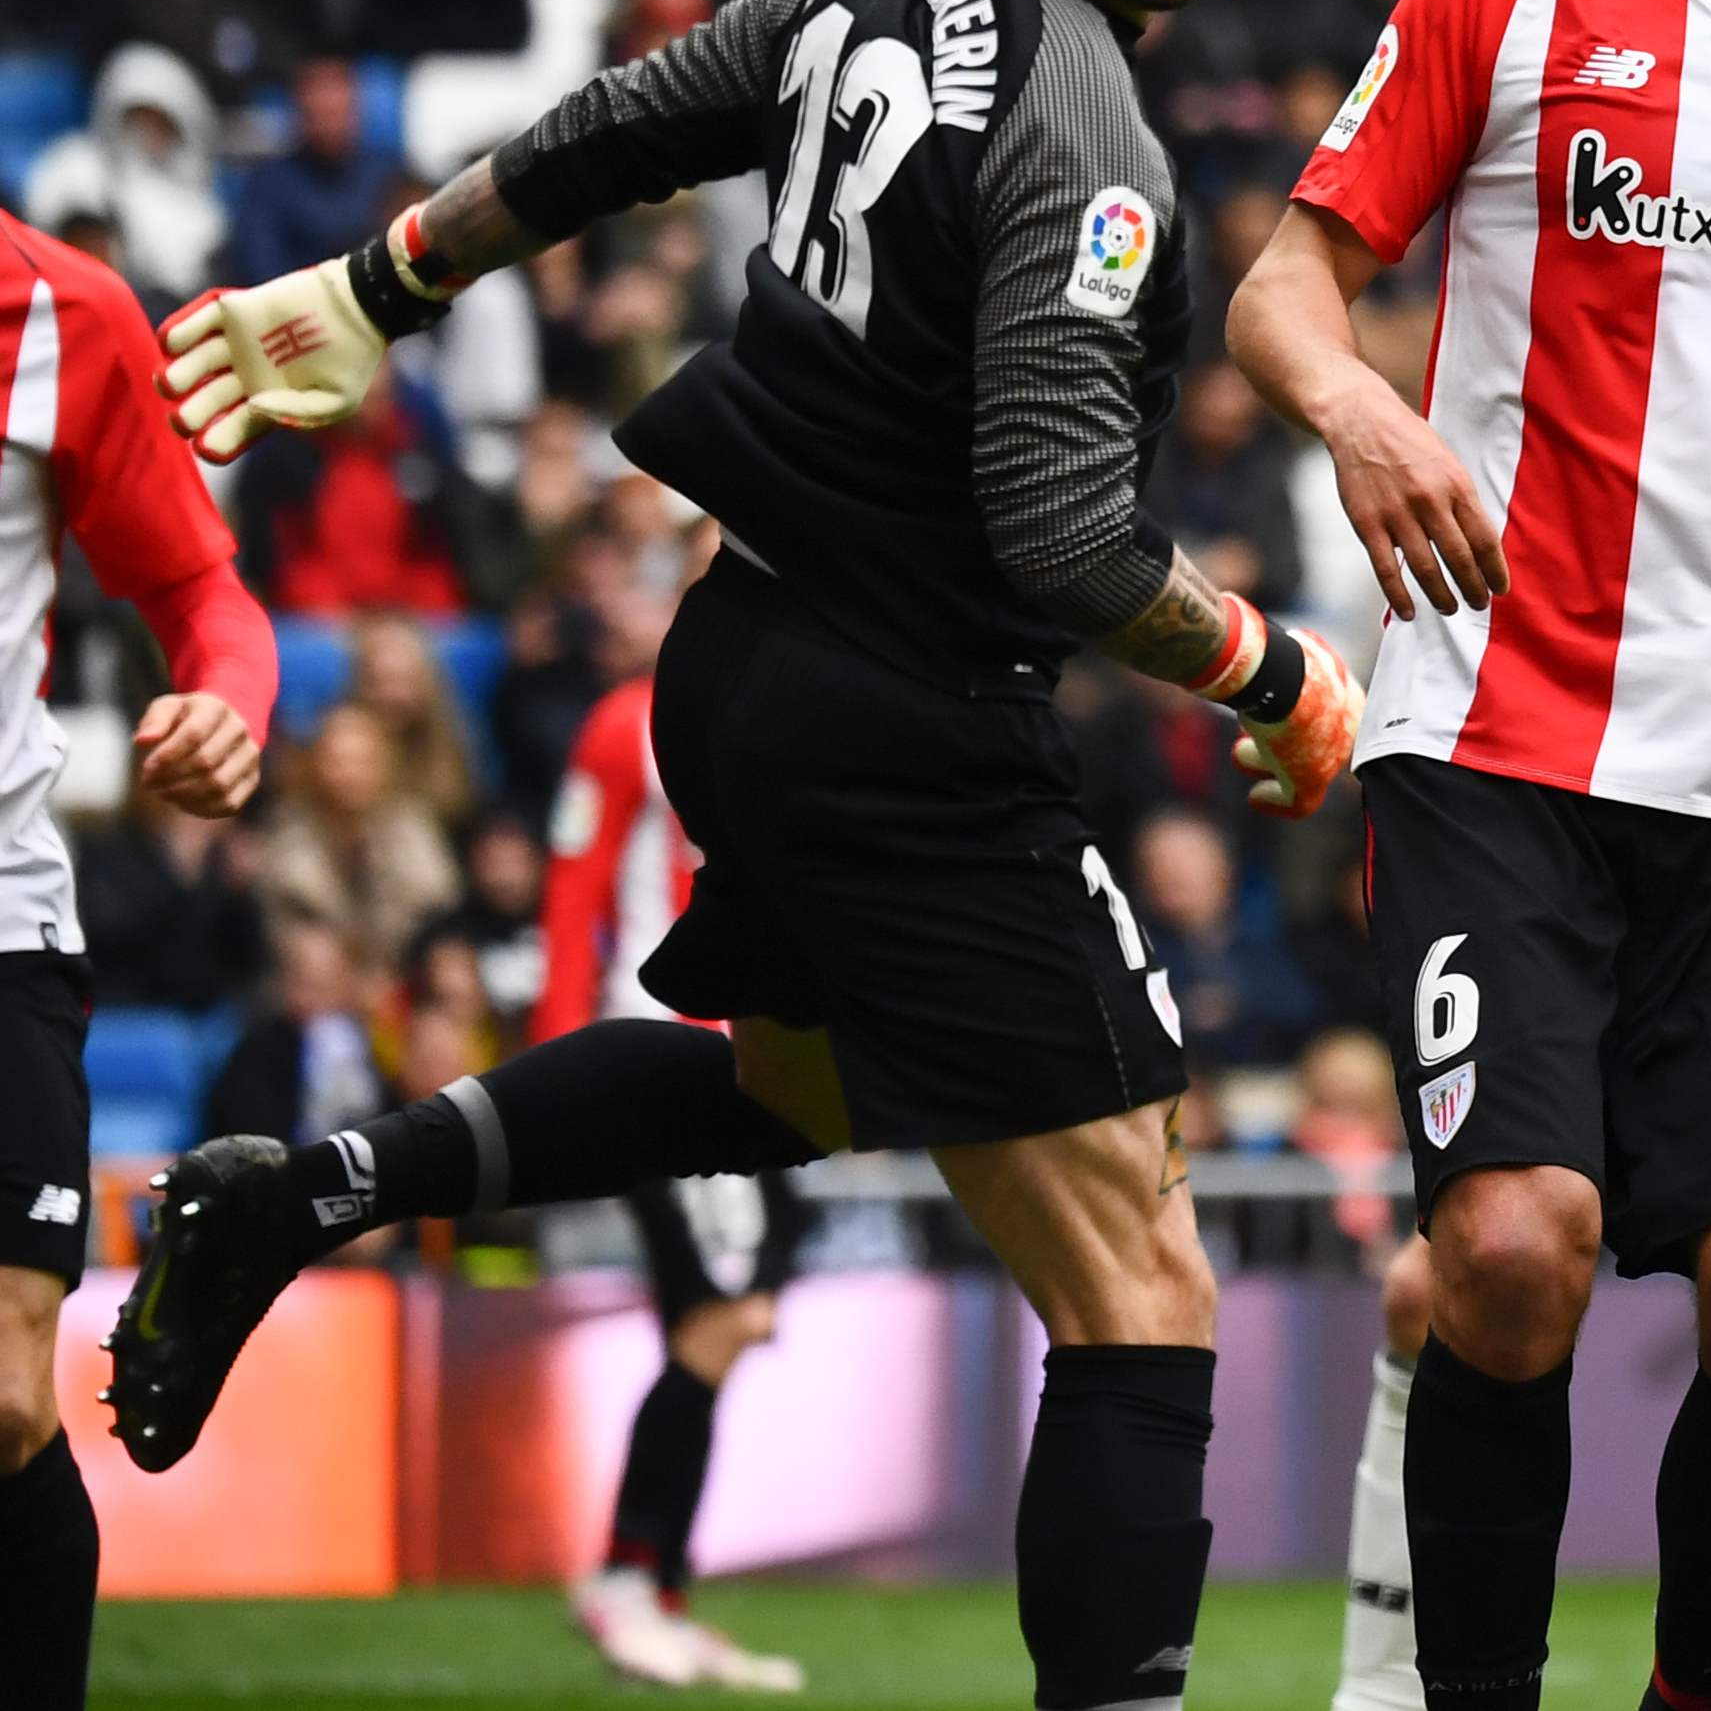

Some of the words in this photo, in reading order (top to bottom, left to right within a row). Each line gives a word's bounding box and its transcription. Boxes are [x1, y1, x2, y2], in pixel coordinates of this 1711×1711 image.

[769, 2, 935, 341] 13
[1081, 845, 1154, 970] 1
[1414, 933, 1480, 1067] 6
